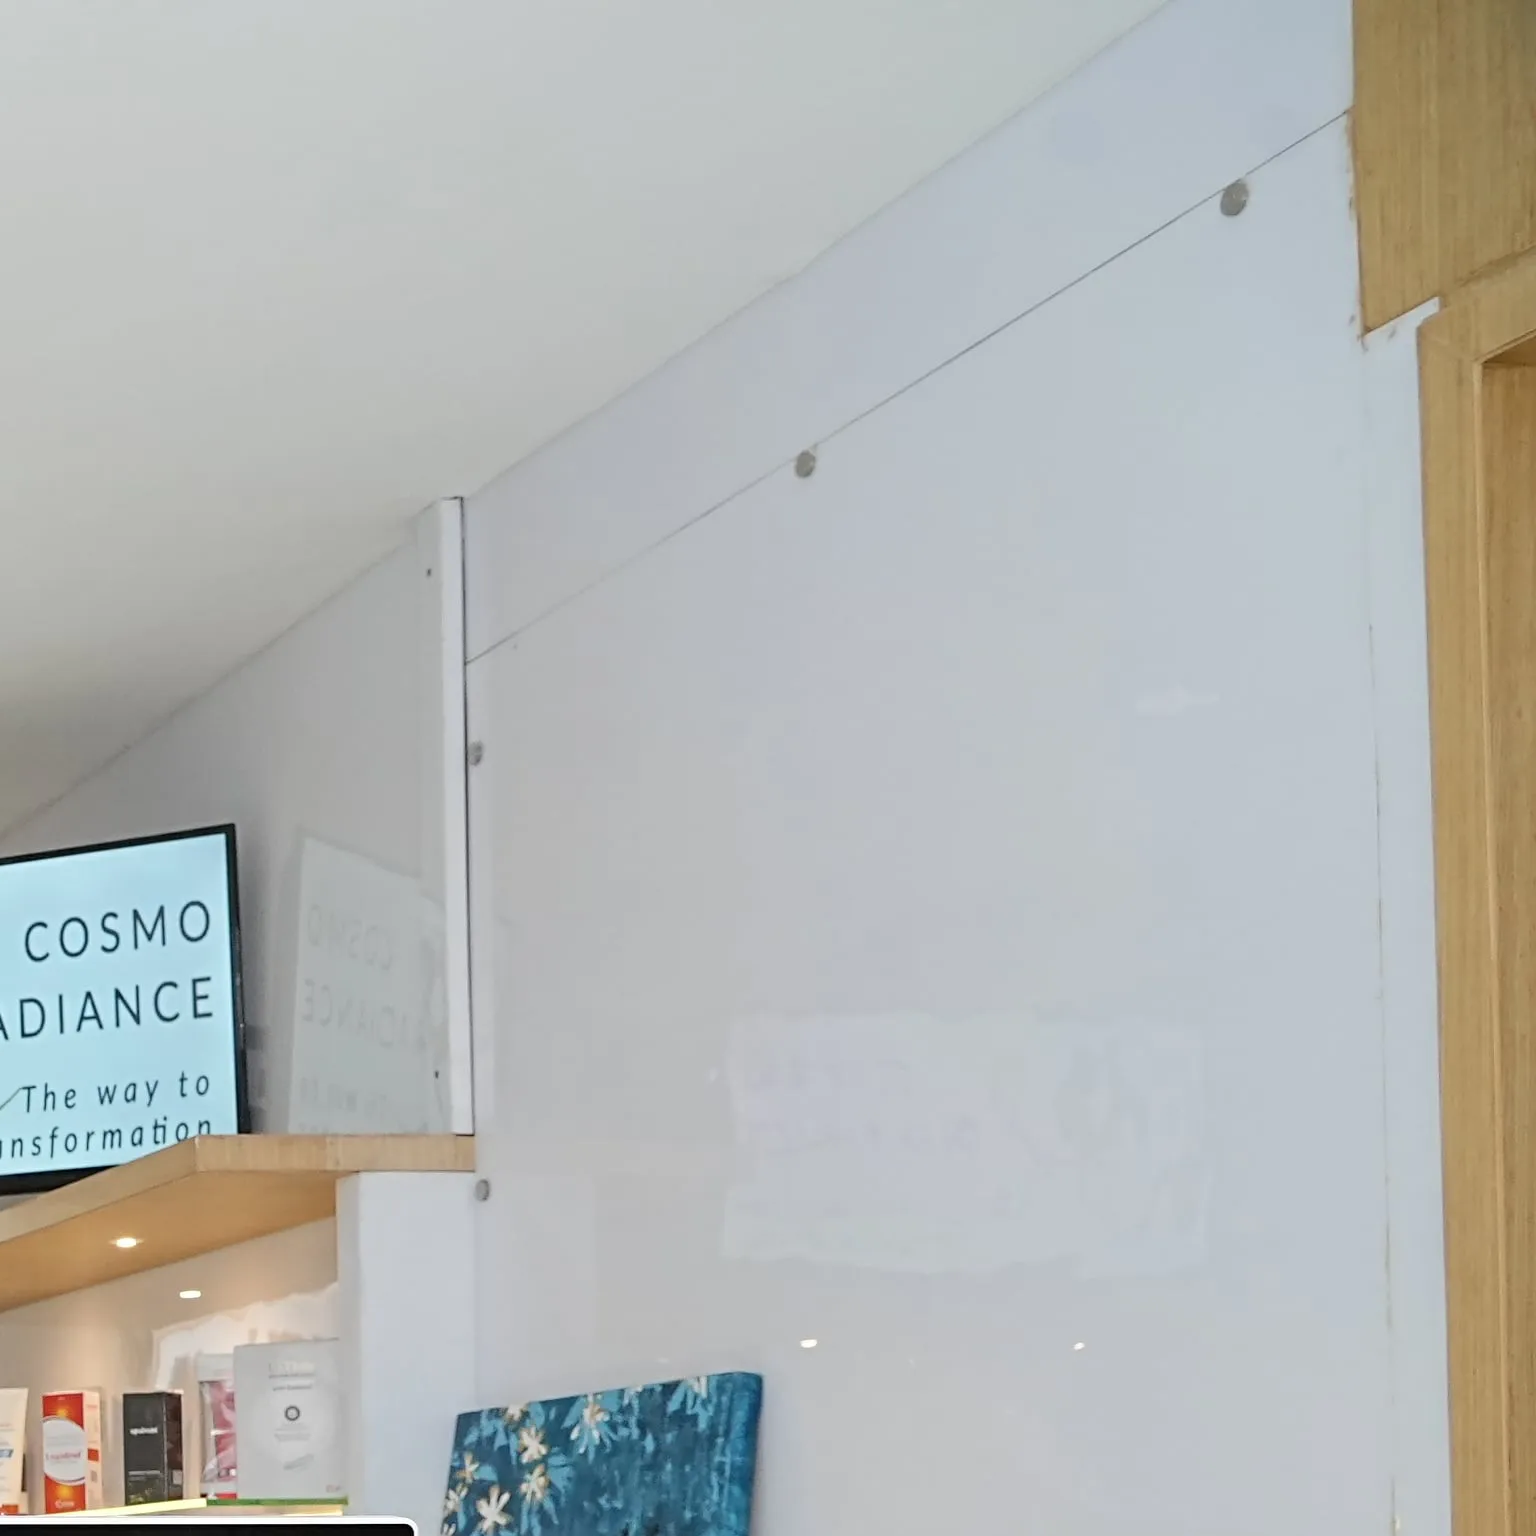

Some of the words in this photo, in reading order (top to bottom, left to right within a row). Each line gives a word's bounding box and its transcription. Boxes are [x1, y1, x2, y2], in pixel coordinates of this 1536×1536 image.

[25, 901, 210, 963] COSMO
[22, 1084, 76, 1113] The
[98, 1078, 159, 1106] way
[180, 1071, 210, 1096] to
